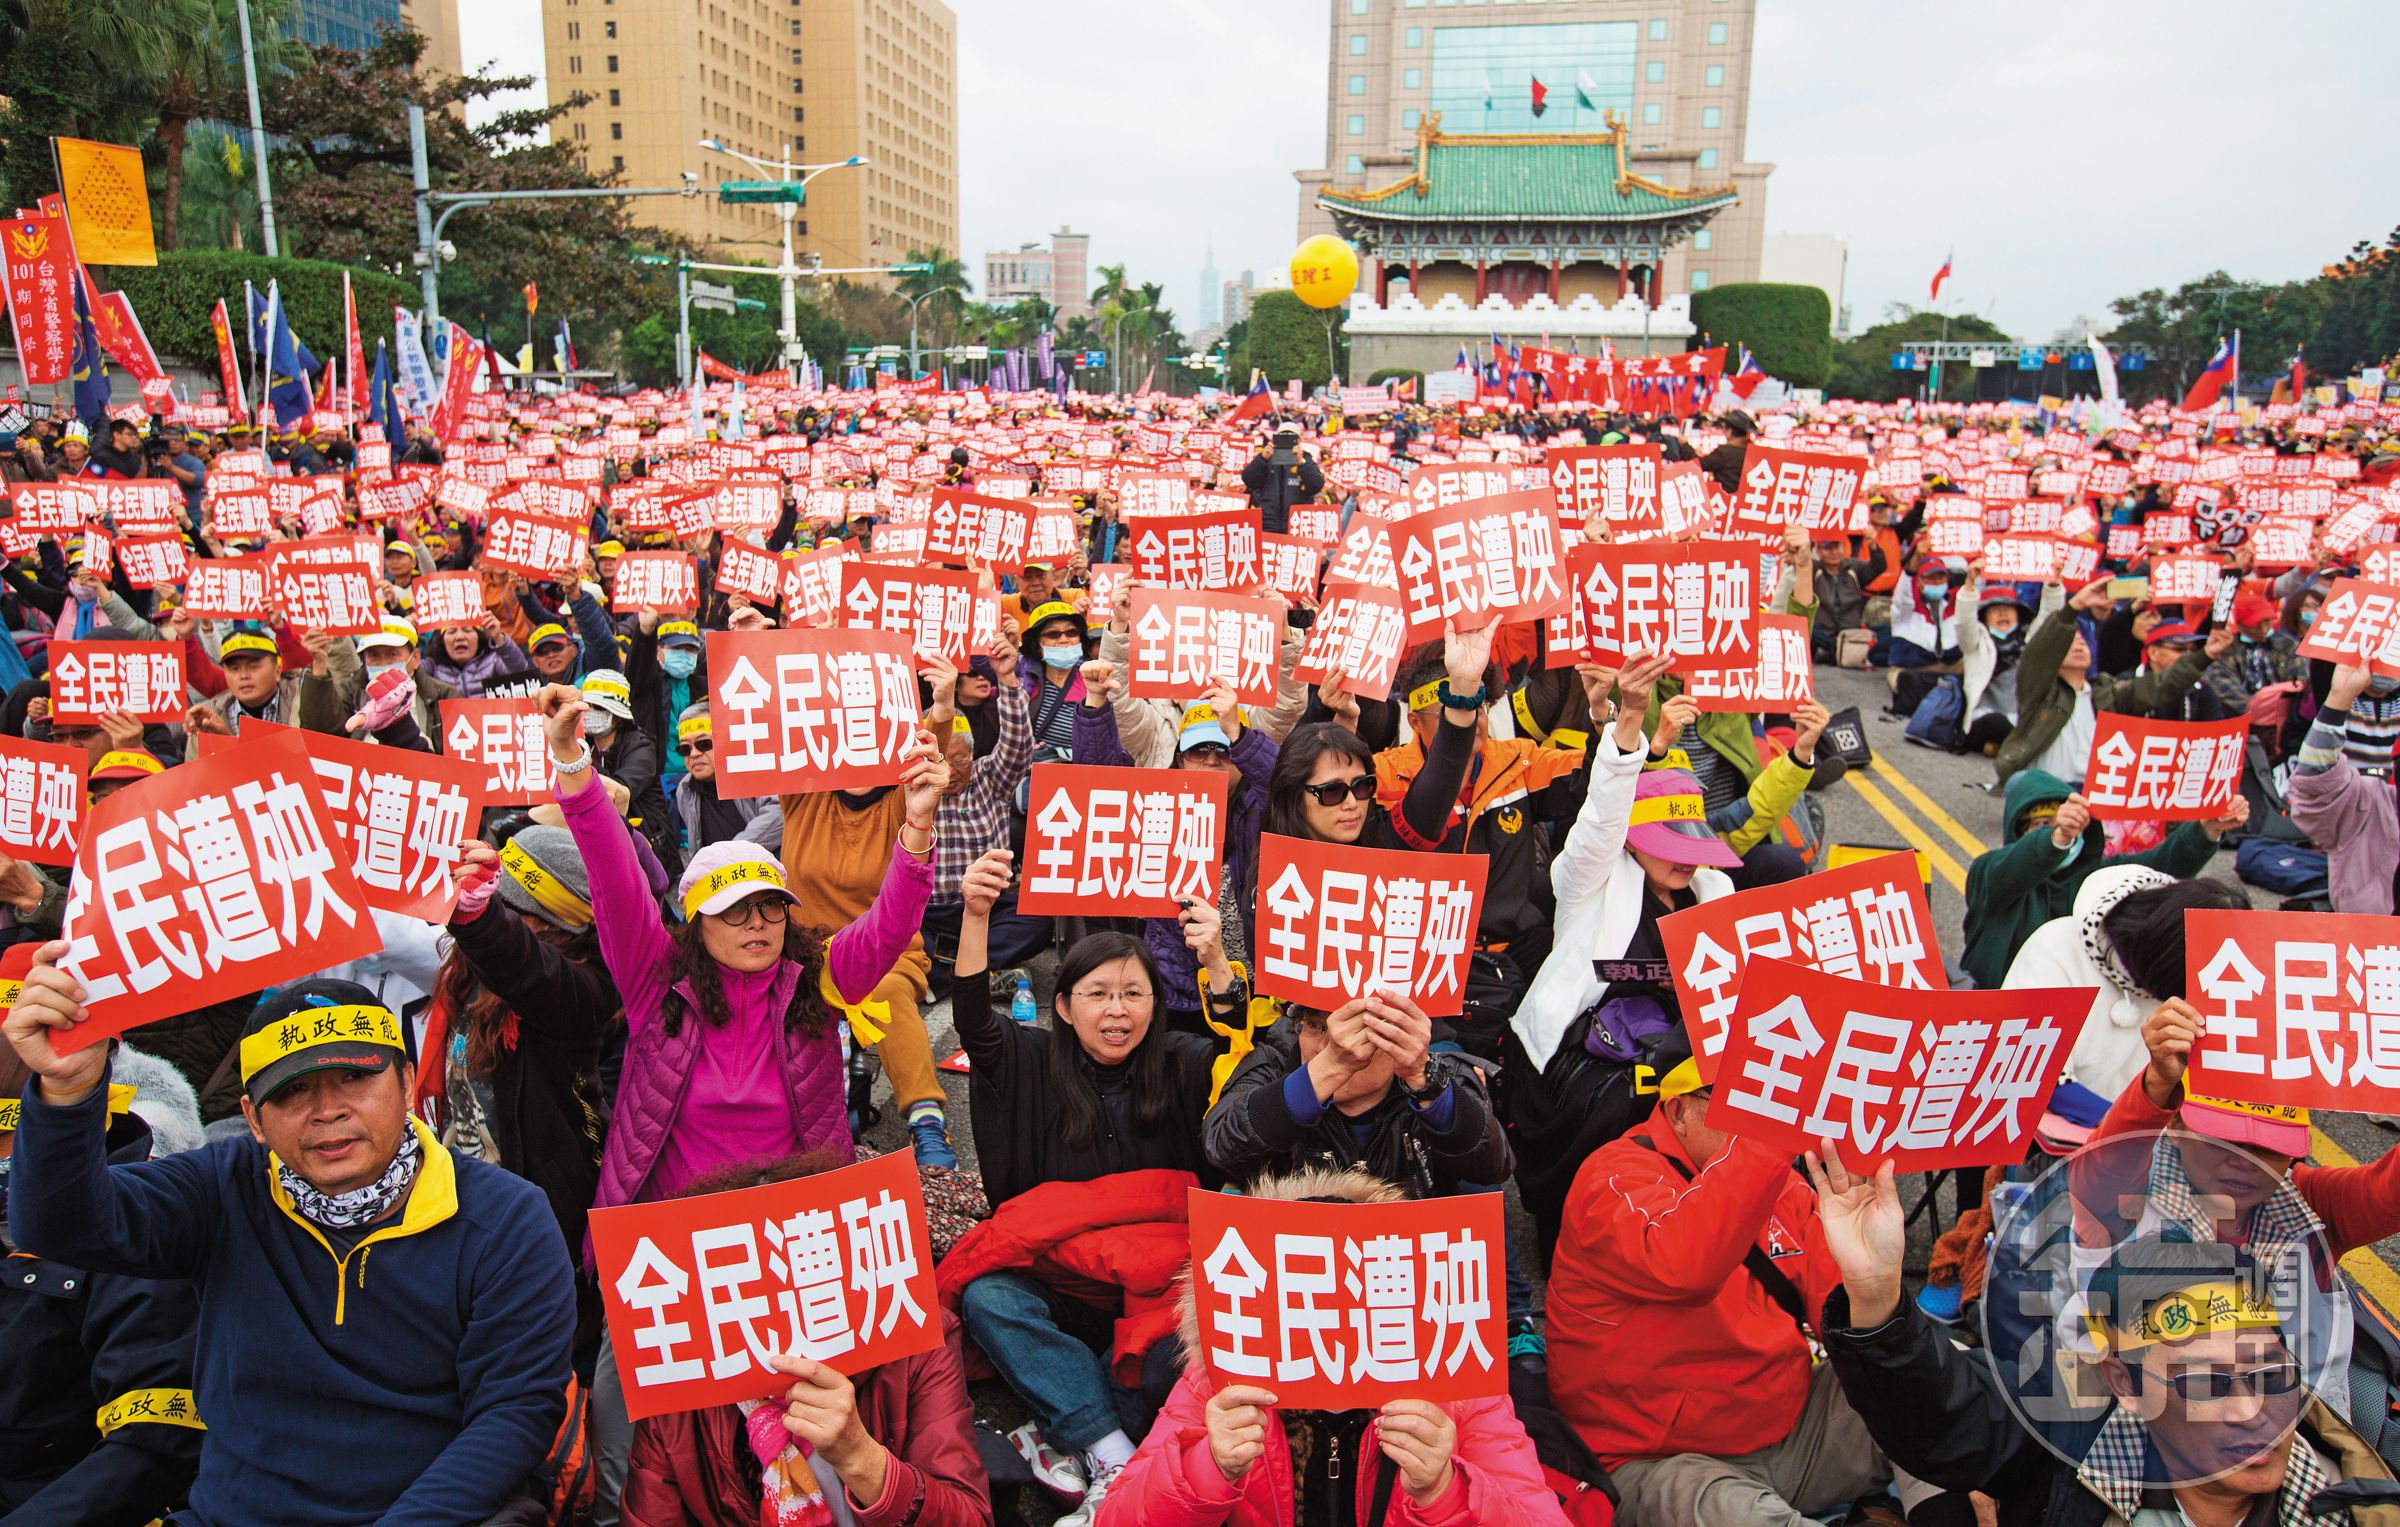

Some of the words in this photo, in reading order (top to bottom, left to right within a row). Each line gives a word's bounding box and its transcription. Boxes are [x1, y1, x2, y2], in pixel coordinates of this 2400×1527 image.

[12, 263, 39, 378] 101期同學會
[38, 260, 65, 379] 台灣省警察學校
[766, 451, 810, 477] 全民遭殃
[1552, 457, 1657, 520] 全民遭殃
[17, 490, 96, 528] 全民遭殃
[109, 487, 170, 520] 全民遭殃
[214, 495, 272, 533] 全民遭殃
[442, 477, 488, 513] 全民遭殃
[541, 483, 584, 518] 全民遭殃
[670, 497, 715, 535] 全民遭
[717, 487, 778, 525] 全民遭殃
[1120, 479, 1189, 516] 全民遭殃
[1738, 458, 1860, 531] 全民遭殃
[2010, 502, 2062, 532] 全民遭殃
[2279, 488, 2332, 515] 全民遭殃
[486, 517, 572, 570] 全民遭殃
[928, 499, 1026, 567] 全民遭殃
[1290, 511, 1339, 543] 全民遭殃
[1929, 521, 1983, 552] 全民遭殃
[2143, 516, 2191, 543] 全民遭殃
[2252, 528, 2312, 561] 全民遭殃
[119, 539, 189, 585] 全民遭殃
[719, 546, 779, 598] 全民遭殃
[1136, 523, 1259, 589] 全民遭殃
[1400, 507, 1561, 625] 全民遭殃
[1984, 539, 2054, 575] 全民遭殃
[2154, 560, 2222, 600] 全民遭殃
[187, 564, 266, 613] 全民遭殃
[283, 572, 376, 628] 全民遭殃
[413, 579, 482, 624] 全民遭殃
[615, 558, 683, 606] 全民遭殃
[846, 577, 971, 660] 全民遭殃
[1584, 560, 1751, 657] 全民遭殃
[1134, 604, 1276, 695] 全民遭殃
[1301, 598, 1406, 692] 全民遭殃
[54, 652, 183, 715] 全民遭殃
[717, 651, 921, 774] 全民遭殃
[447, 713, 560, 793] 全民遭
[2088, 731, 2245, 810] 全民遭殃
[1667, 801, 1705, 817] 執政
[1029, 786, 1216, 900] 全民遭殃
[1264, 861, 1475, 998] 全民遭殃
[278, 1010, 398, 1050] 執政無能
[1726, 994, 2061, 1155] 全民遭殃
[615, 1189, 927, 1388] 全民遭殃
[1202, 1227, 1495, 1386] 全民遭殃
[2129, 1289, 2269, 1339] 執政無能
